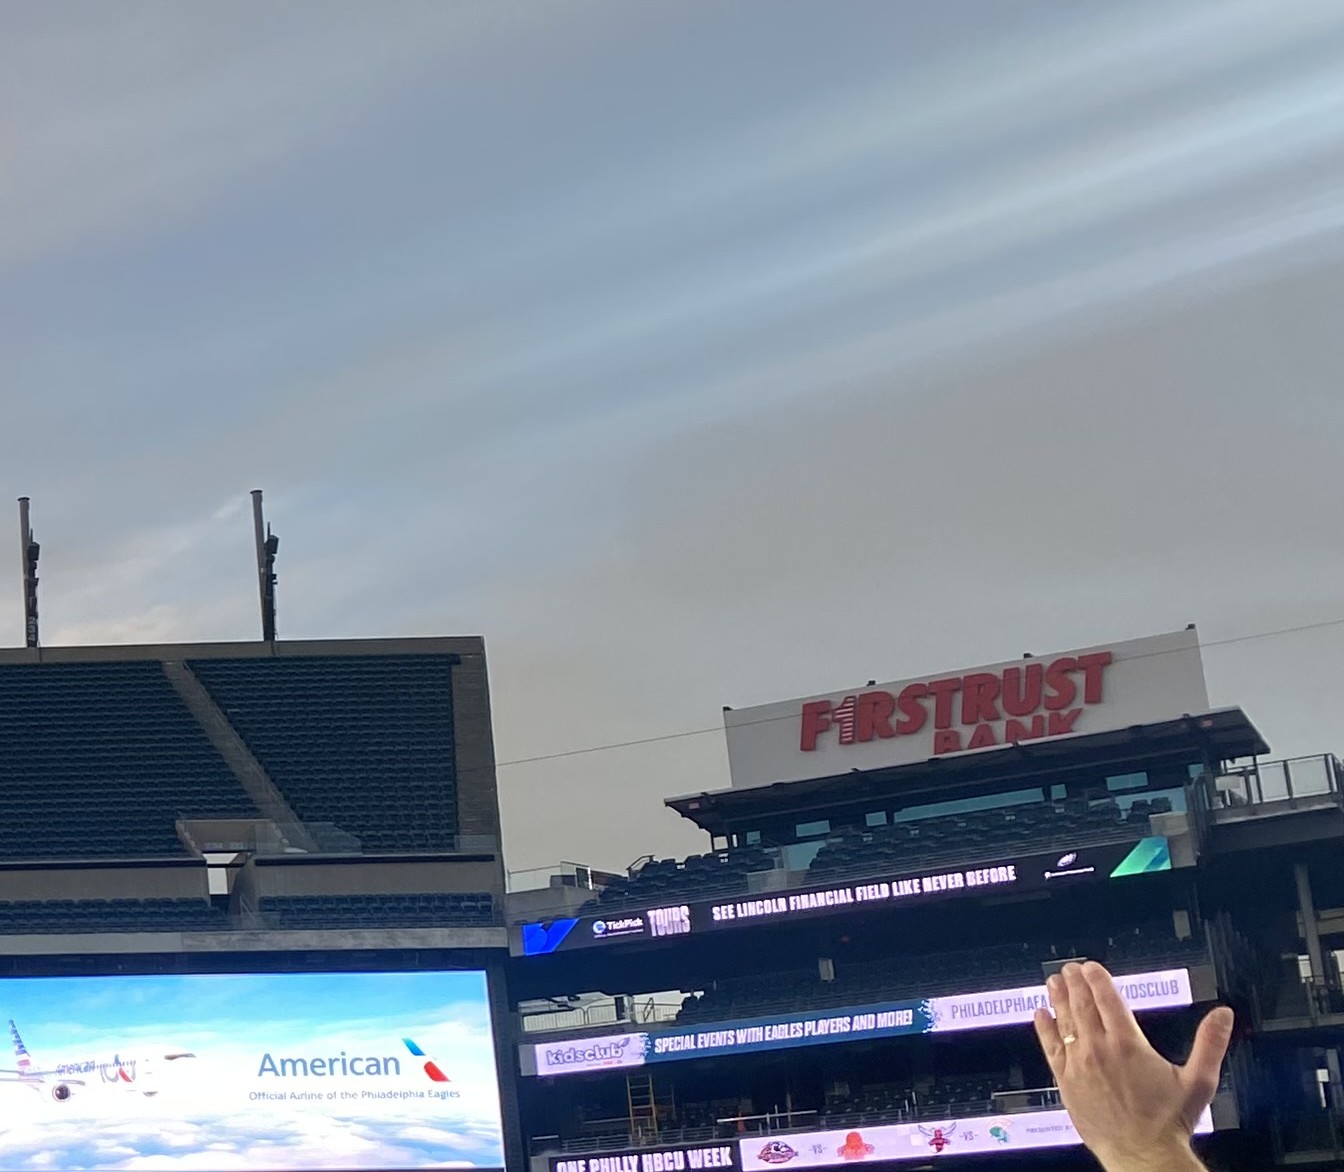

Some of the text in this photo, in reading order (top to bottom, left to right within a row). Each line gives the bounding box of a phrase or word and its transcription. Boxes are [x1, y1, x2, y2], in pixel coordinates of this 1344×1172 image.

[934, 708, 1083, 755] BANK
[712, 865, 1016, 921] SEE LINCOLN FINANCIAL FIELD LIKE NEVER BEFORE
[647, 905, 691, 937] TOURS
[654, 1009, 913, 1054] SPECIAL EVENTS WITH EAGLES PLAYERS AND MORE!
[257, 1051, 401, 1077] American
[546, 1043, 623, 1066] kidsclub
[248, 1088, 461, 1101] Official Airline of the Philadelphia Eagles
[687, 1146, 733, 1169] WEEK
